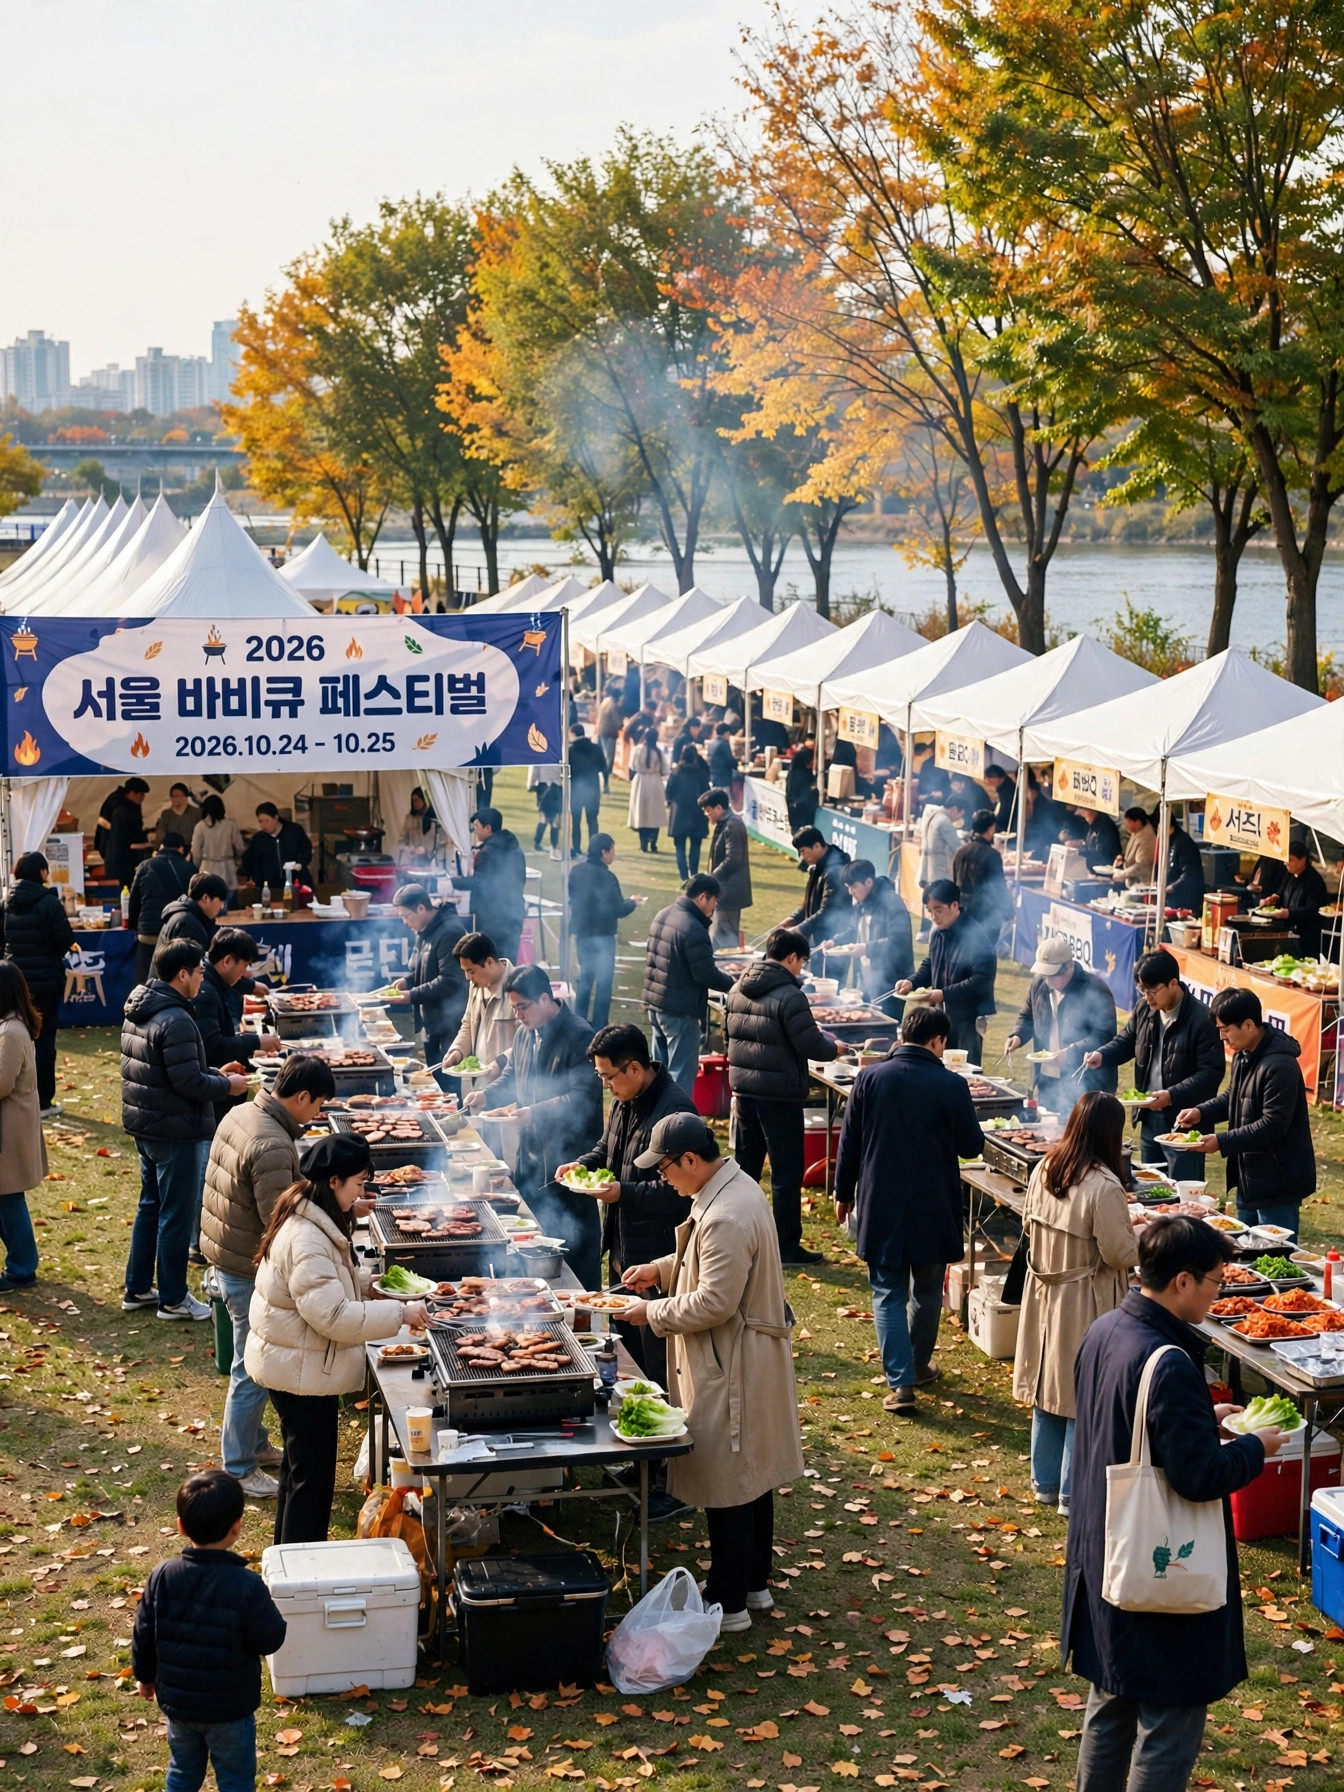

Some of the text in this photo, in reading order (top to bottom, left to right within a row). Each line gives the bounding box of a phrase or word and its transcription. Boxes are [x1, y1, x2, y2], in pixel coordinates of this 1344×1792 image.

[245, 634, 325, 662] 2026
[73, 671, 487, 722] 서울 바비큐 페스티벌
[175, 734, 308, 757] 2026.10.24
[333, 732, 396, 754] 10.25
